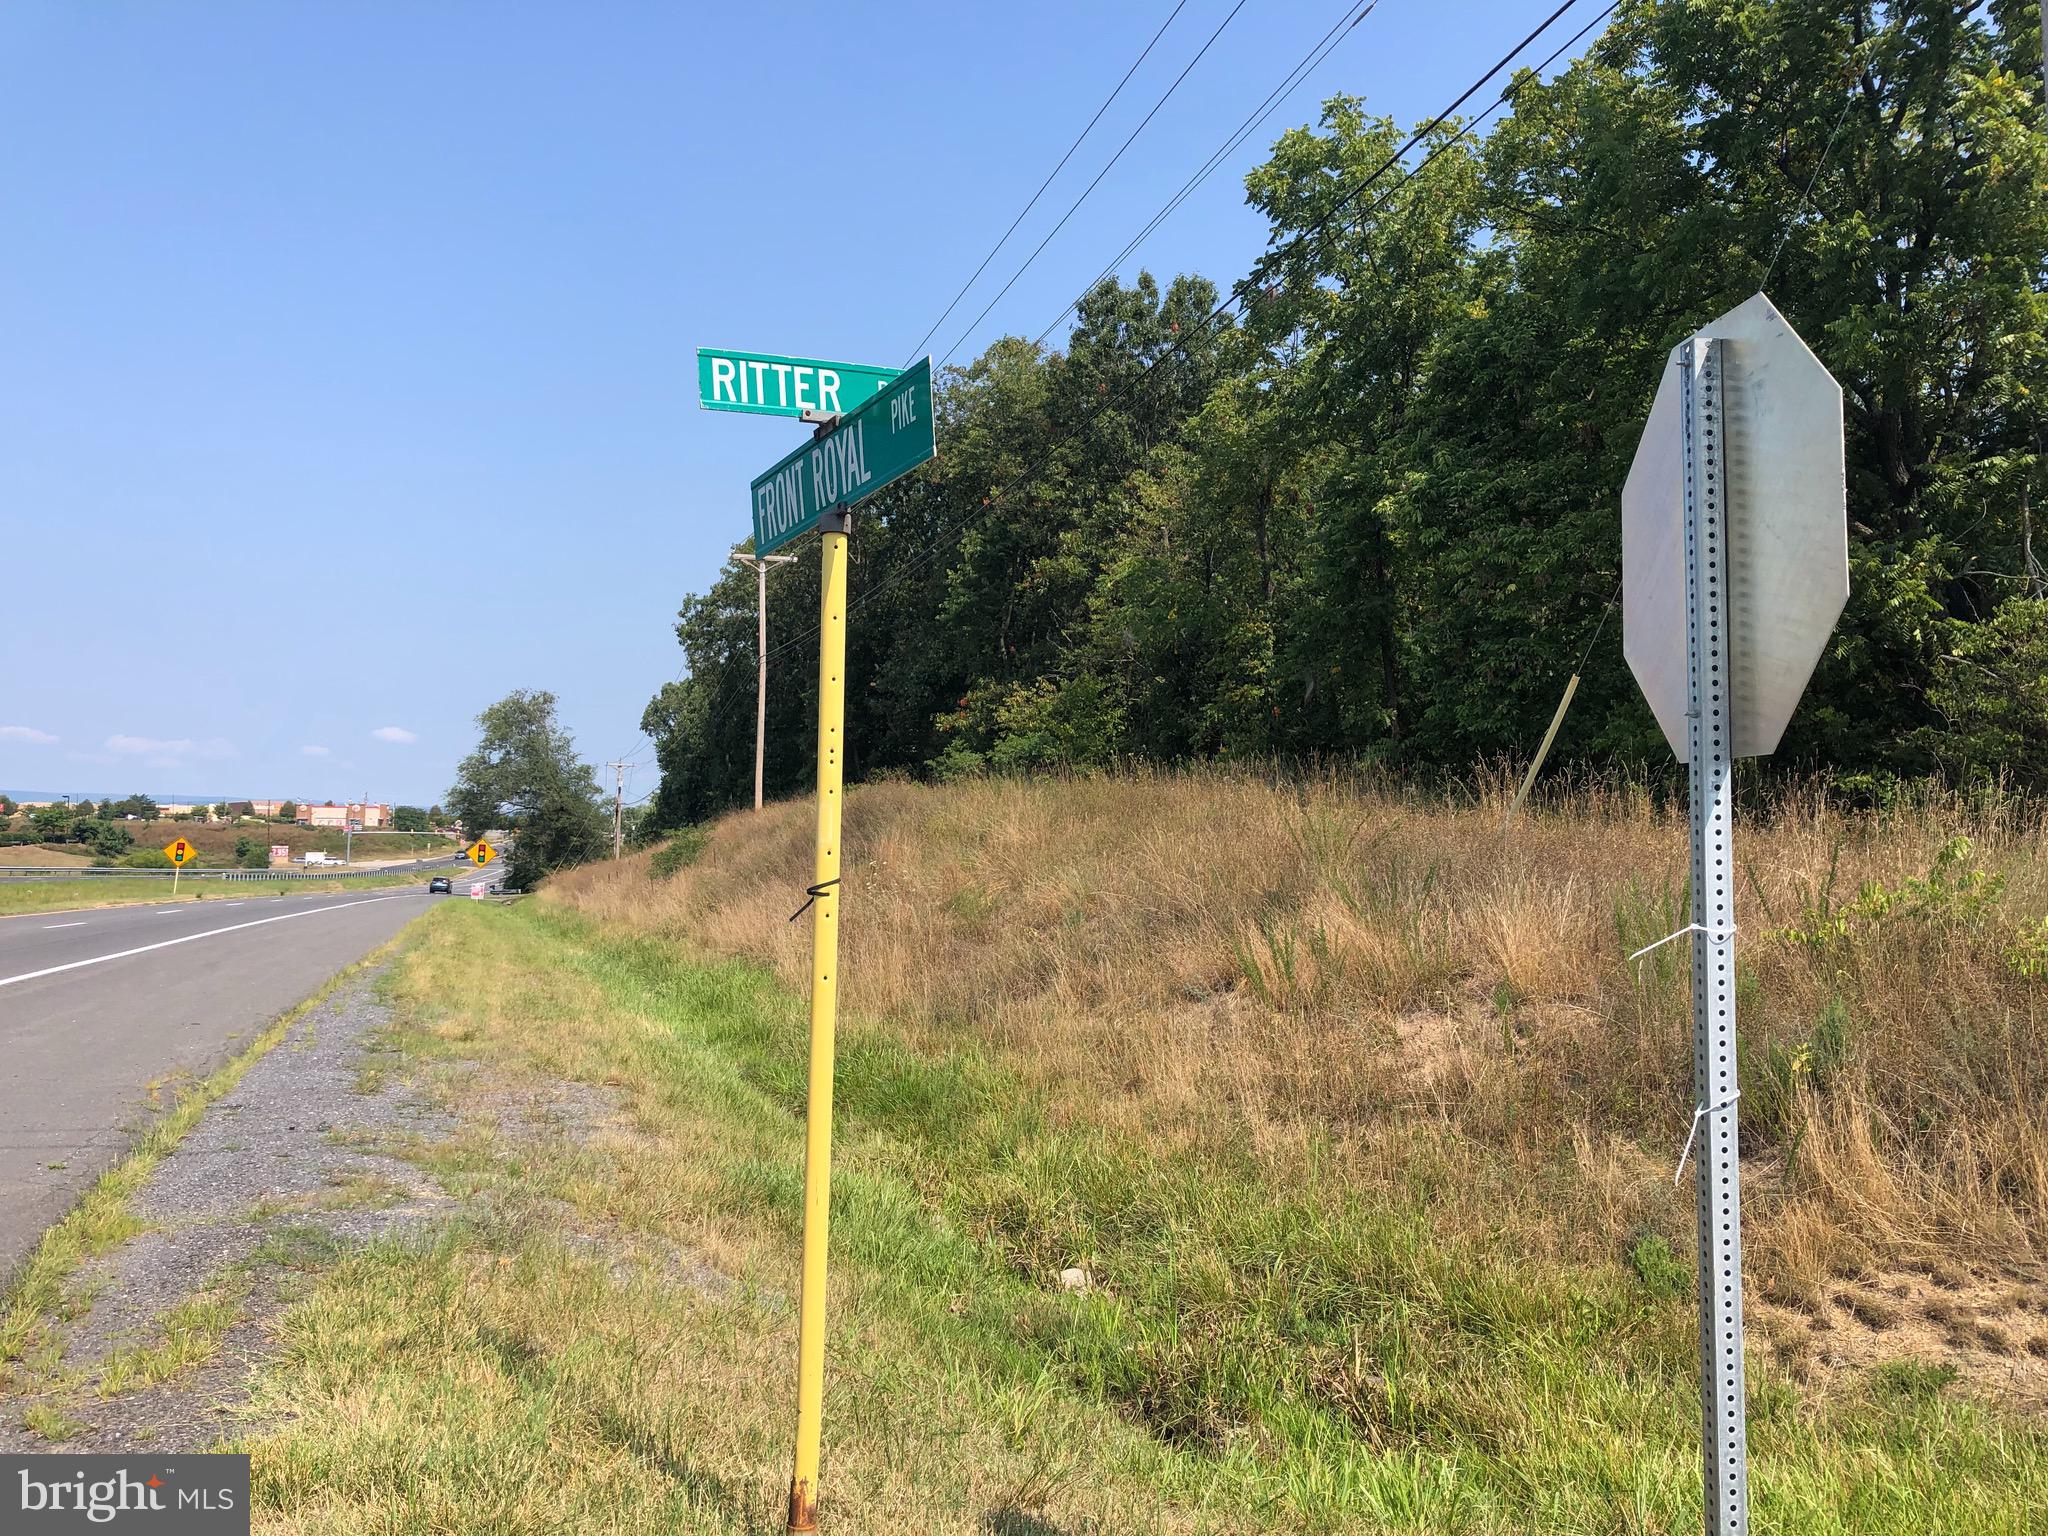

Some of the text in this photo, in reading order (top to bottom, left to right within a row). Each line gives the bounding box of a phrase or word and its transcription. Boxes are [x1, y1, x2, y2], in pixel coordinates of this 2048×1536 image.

[711, 358, 841, 411] RITTER
[757, 386, 917, 544] FRONT ROYAL PIKE
